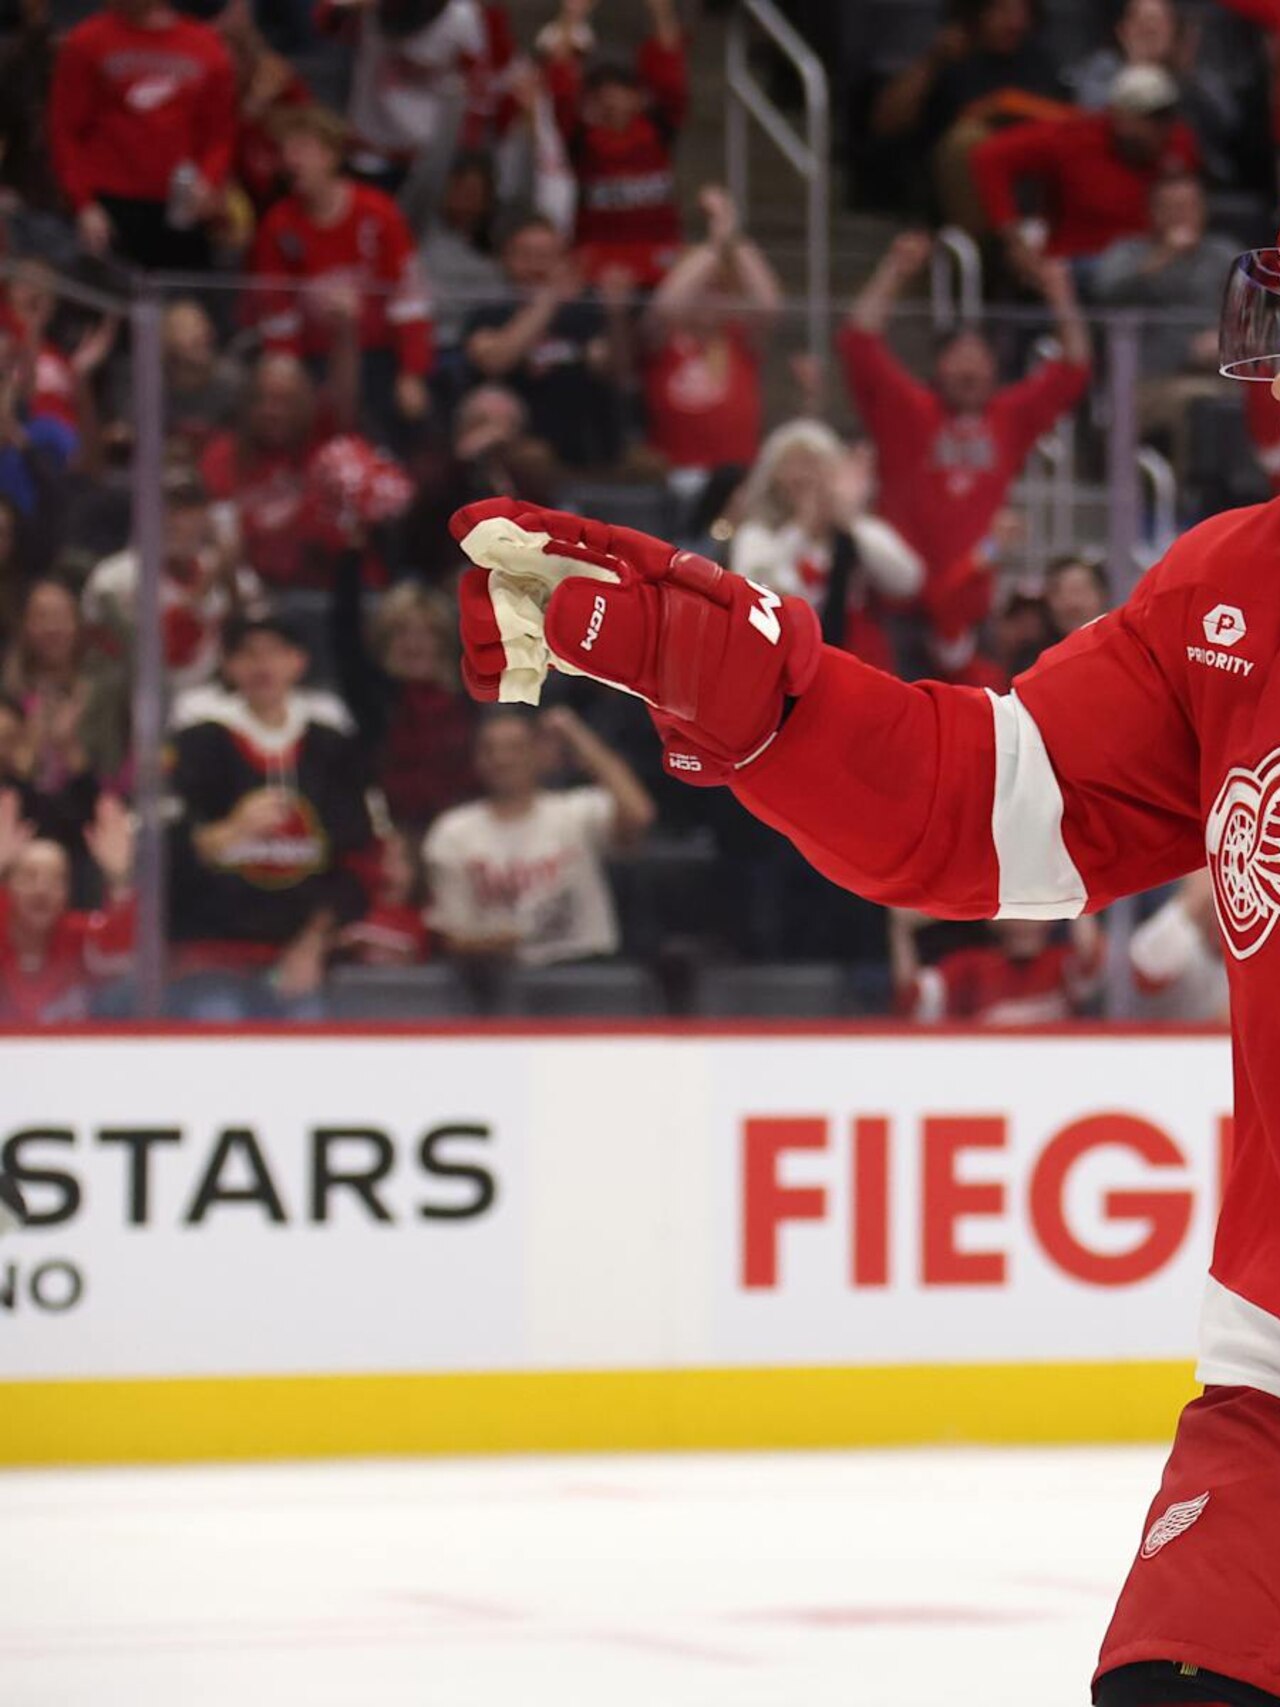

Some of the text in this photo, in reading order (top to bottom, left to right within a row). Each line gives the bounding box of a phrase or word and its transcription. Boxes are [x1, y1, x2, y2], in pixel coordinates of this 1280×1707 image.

[580, 595, 607, 651] CCM
[1186, 645, 1255, 677] PRIORITY
[1, 1123, 499, 1225] STARS
